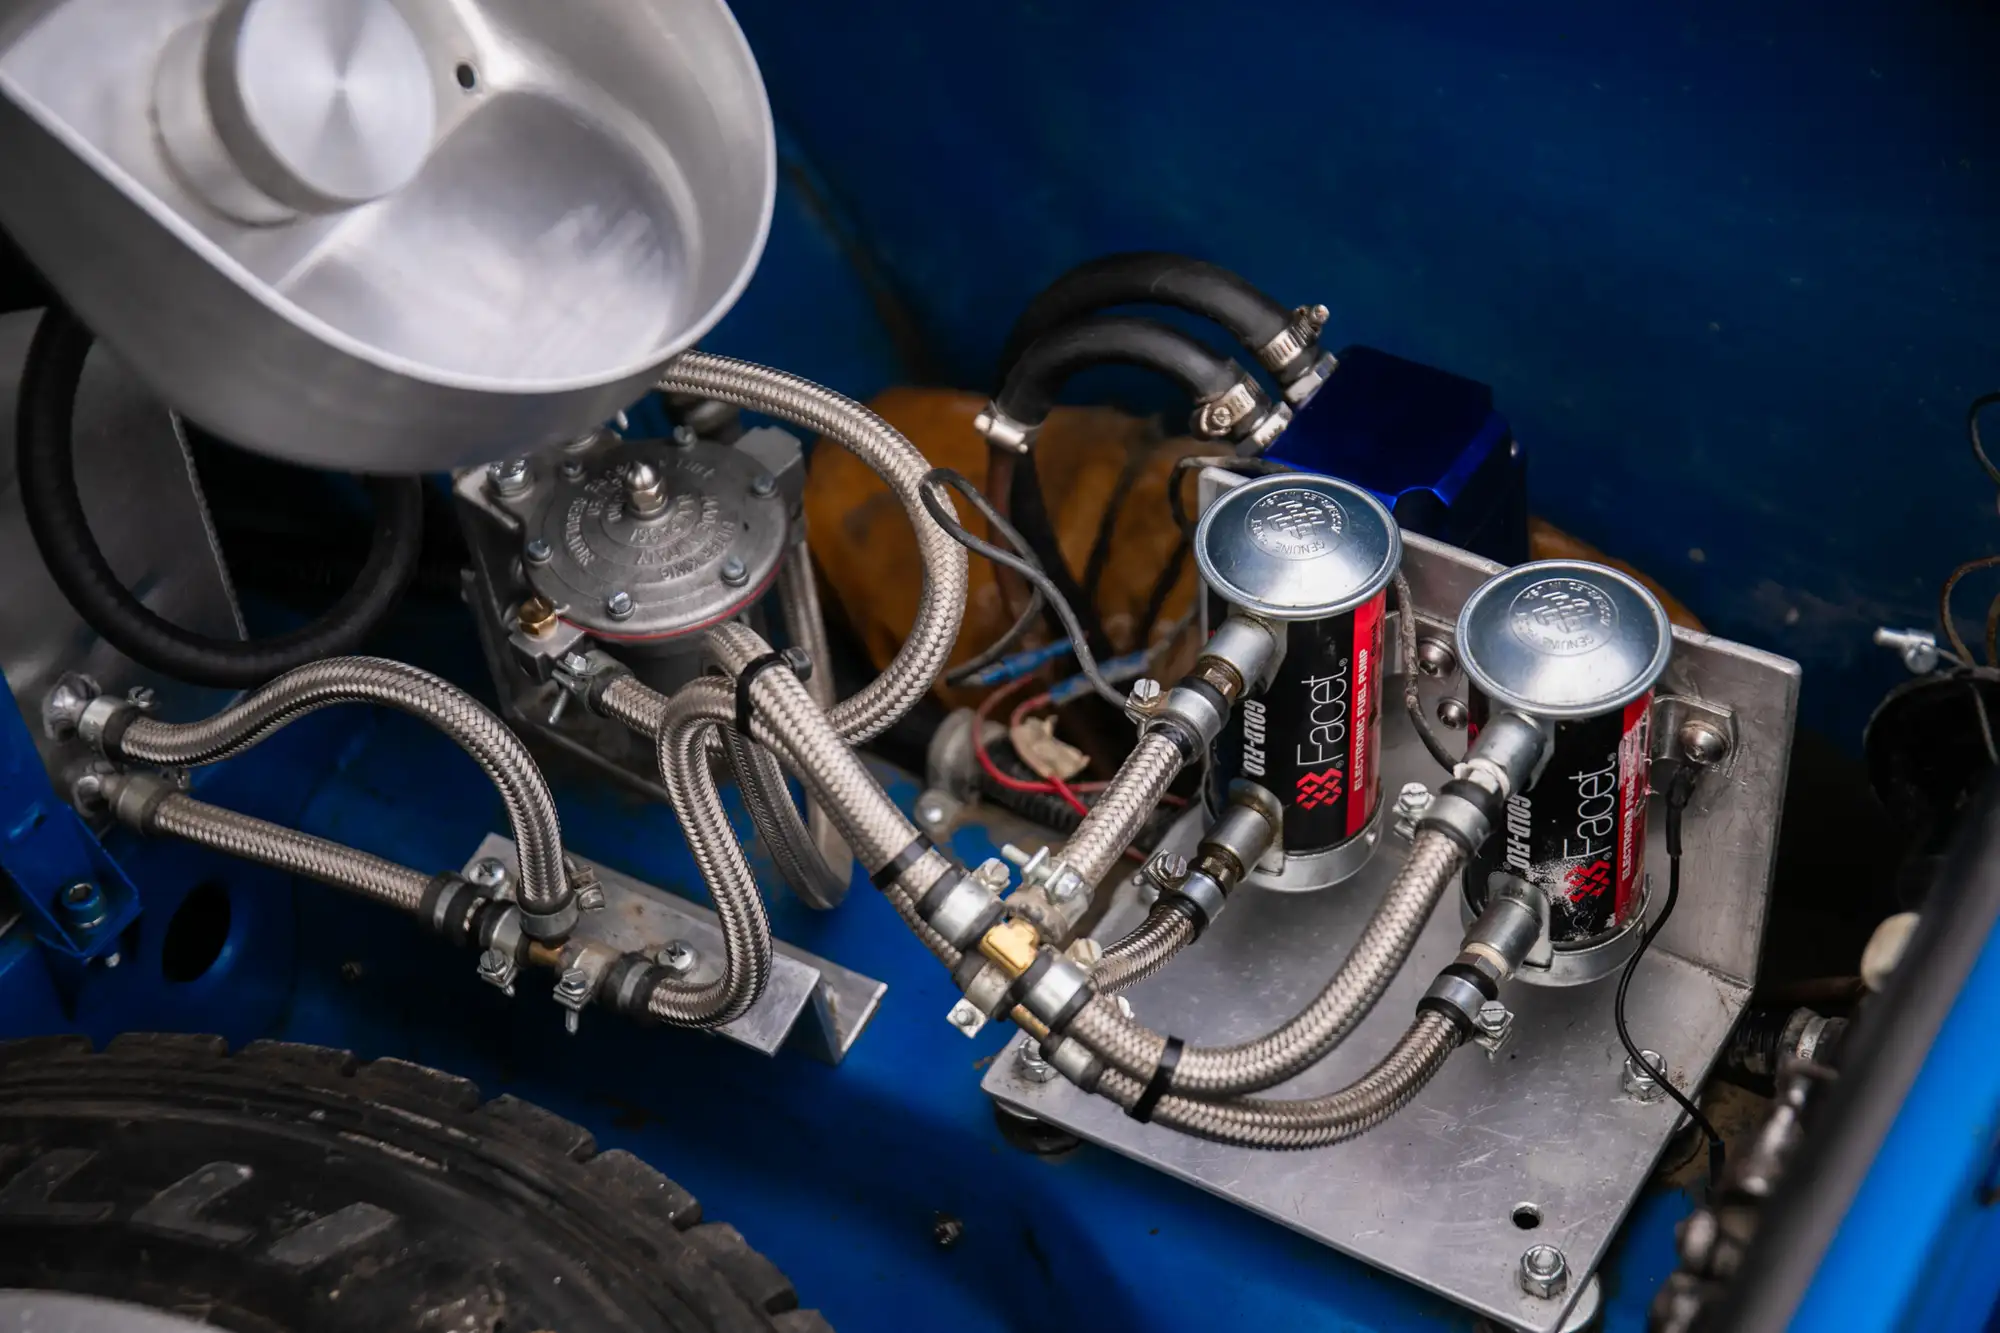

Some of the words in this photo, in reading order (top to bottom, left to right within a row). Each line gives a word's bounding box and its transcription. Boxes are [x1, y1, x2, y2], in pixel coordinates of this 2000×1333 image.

[1273, 540, 1325, 555] GENUINE
[1357, 682, 1368, 717] FUEL
[1358, 648, 1369, 681] PUMP
[1243, 699, 1267, 777] GOLD-FLO
[1297, 668, 1348, 766] Facet
[1353, 717, 1366, 792] ELECTRONIC
[1506, 793, 1532, 870] GOLD-FLO
[1564, 760, 1617, 860] Facet
